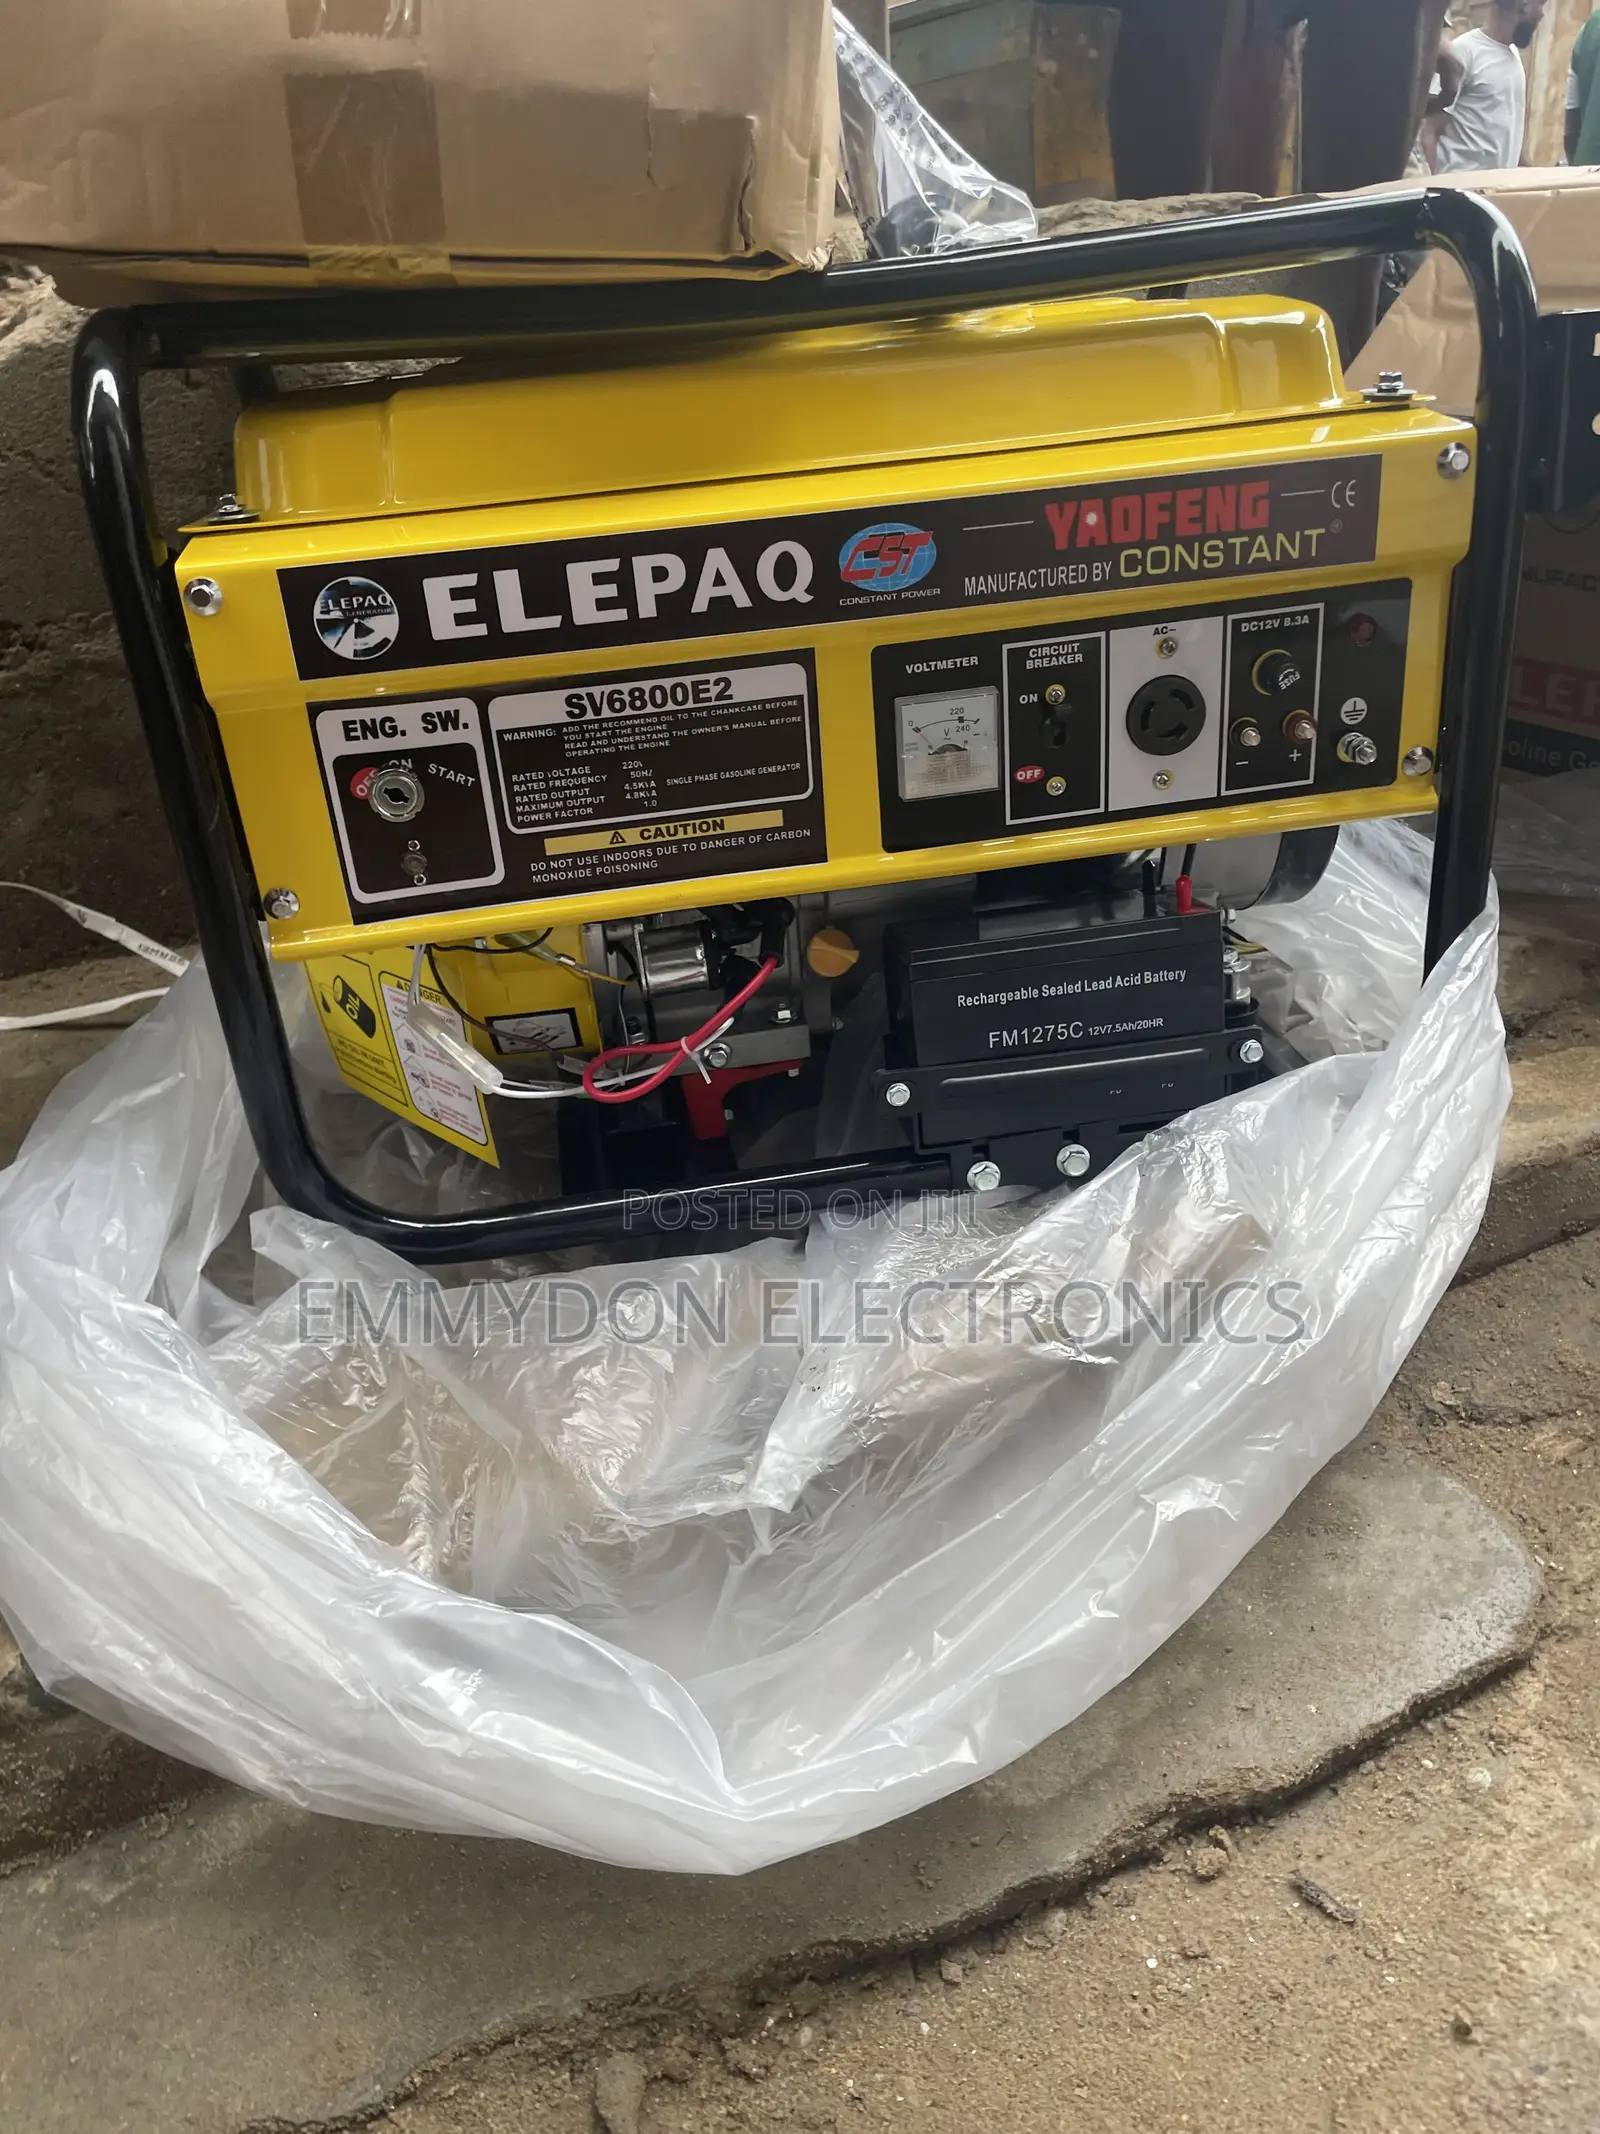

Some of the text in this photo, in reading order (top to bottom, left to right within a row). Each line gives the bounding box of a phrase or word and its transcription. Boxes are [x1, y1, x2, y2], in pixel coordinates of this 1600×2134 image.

[1044, 480, 1271, 551] YAOFENG
[964, 527, 1326, 597] MANUFACTURED BY CONSTANT
[422, 540, 815, 641] ELEPAQ
[839, 587, 941, 606] CONSTANT POWER
[319, 593, 392, 612] ELEPAQ
[1241, 614, 1310, 633] DC12V 8.3A
[1028, 642, 1080, 659] CIRCUIT
[905, 655, 979, 674] VOLTMETER
[1025, 653, 1083, 670] BREAKER
[1278, 671, 1300, 691] FUSE
[564, 676, 734, 720] SV6800E2
[1019, 693, 1039, 705] ON
[502, 700, 798, 742] WARNING: ADD THE RECOMMEND OIL TO THE CHANKCASE BEFORE
[949, 706, 965, 716] 220
[341, 709, 470, 742] ENG. SW.
[563, 723, 668, 742] YOU START THE ENGINE
[564, 715, 802, 750] READ AND UNDERSTAND THE OWNER'S MANUAL BEFORE
[955, 724, 971, 733] 240
[565, 740, 671, 758] OPERATING THE ENGINE
[428, 763, 476, 788] START
[511, 771, 545, 783] RATED
[513, 781, 546, 792] RATED
[549, 774, 608, 788] FREQUENCY
[665, 762, 801, 787] SINGLE PHASE GASOLINE GENERATOR
[1016, 769, 1042, 781] OFF
[515, 792, 548, 804] RATED
[550, 787, 591, 799] OUTPUT
[515, 801, 564, 813] MAXIMUM
[566, 795, 606, 807] OUTPUT
[517, 799, 658, 823] POWER FACTOR 1.0
[638, 818, 726, 841] CAUTION
[530, 829, 812, 873] DO NOT USE INDOORS DUE TO DANGER OF CARBON
[531, 859, 659, 884] MONOXIDE POISONING
[956, 969, 1187, 1007] Rechargeable Sealed Lead Acid Battery
[345, 993, 360, 1019] OIL
[988, 1017, 1164, 1049] FM1275C 12V7.5Ah/20HR
